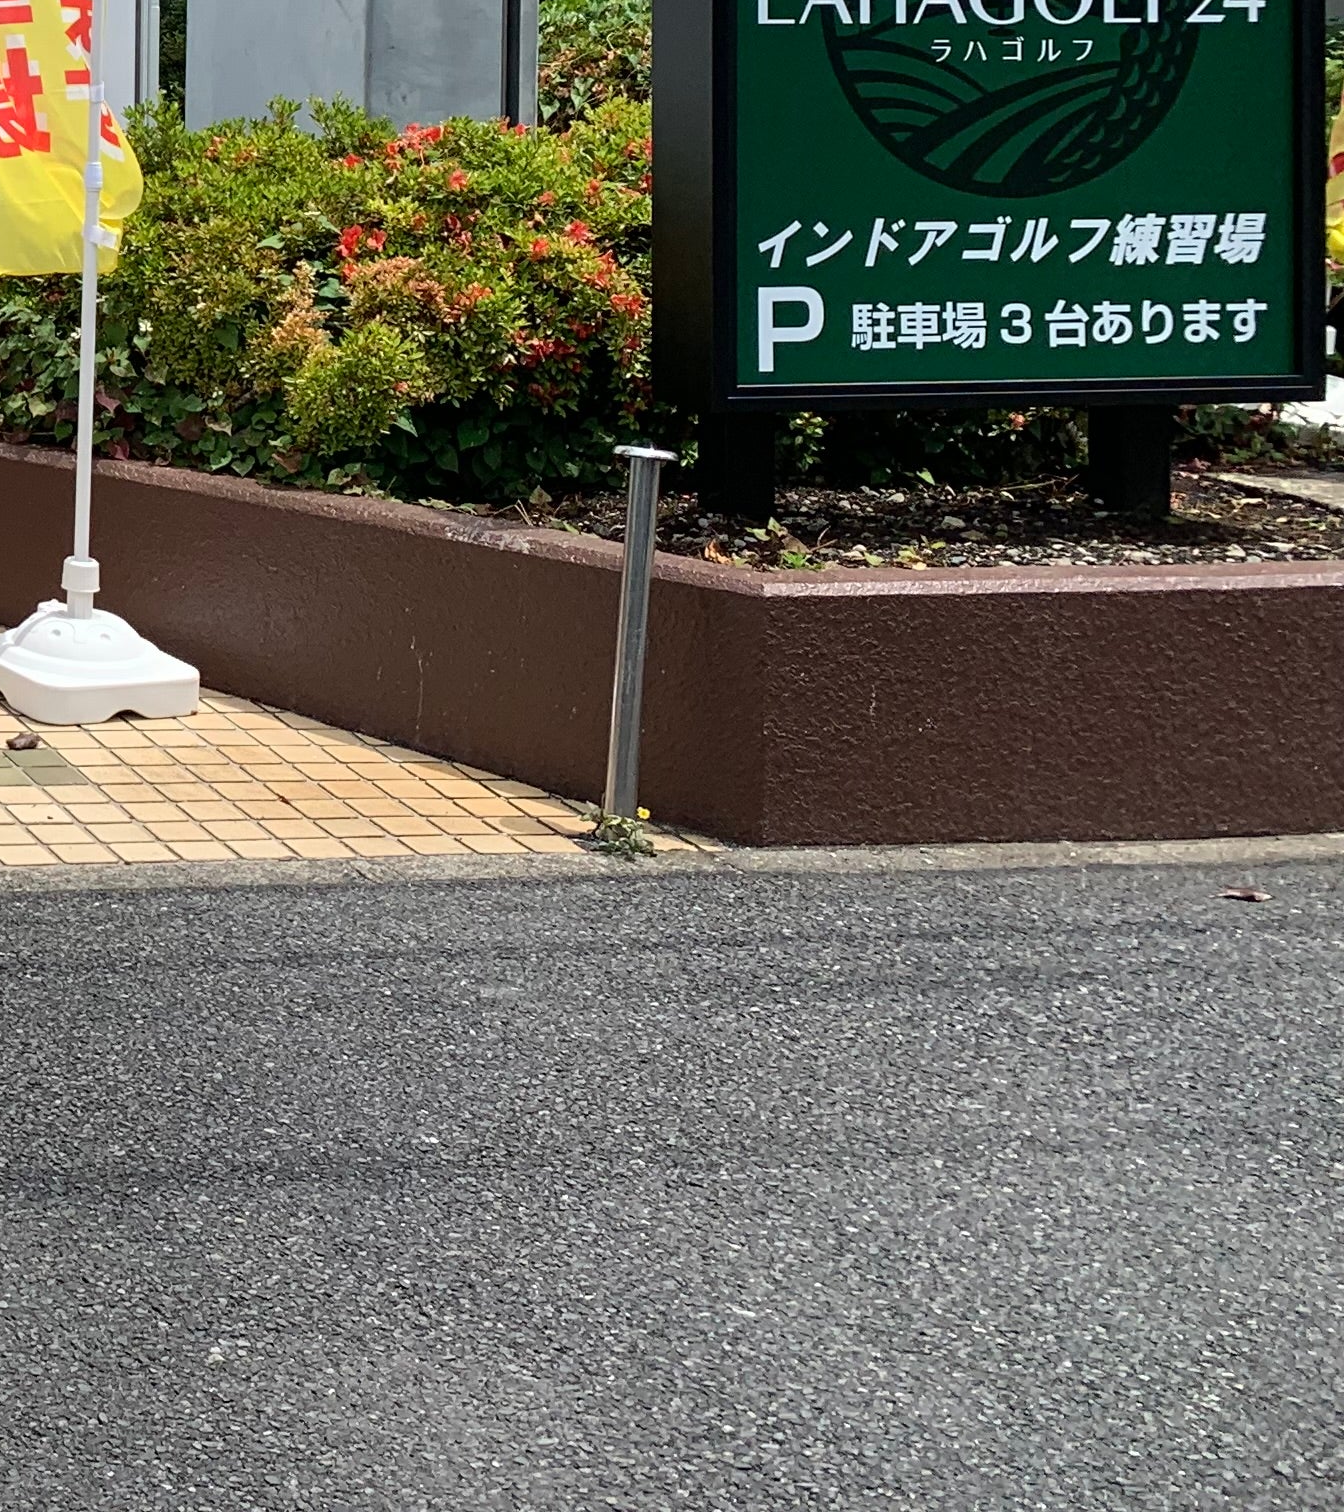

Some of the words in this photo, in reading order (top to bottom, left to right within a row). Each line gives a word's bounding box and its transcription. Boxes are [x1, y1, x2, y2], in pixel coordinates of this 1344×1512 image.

[929, 37, 1095, 63] ラハゴルフ
[758, 212, 1268, 268] インドアゴルフ練習場
[758, 286, 825, 372] P
